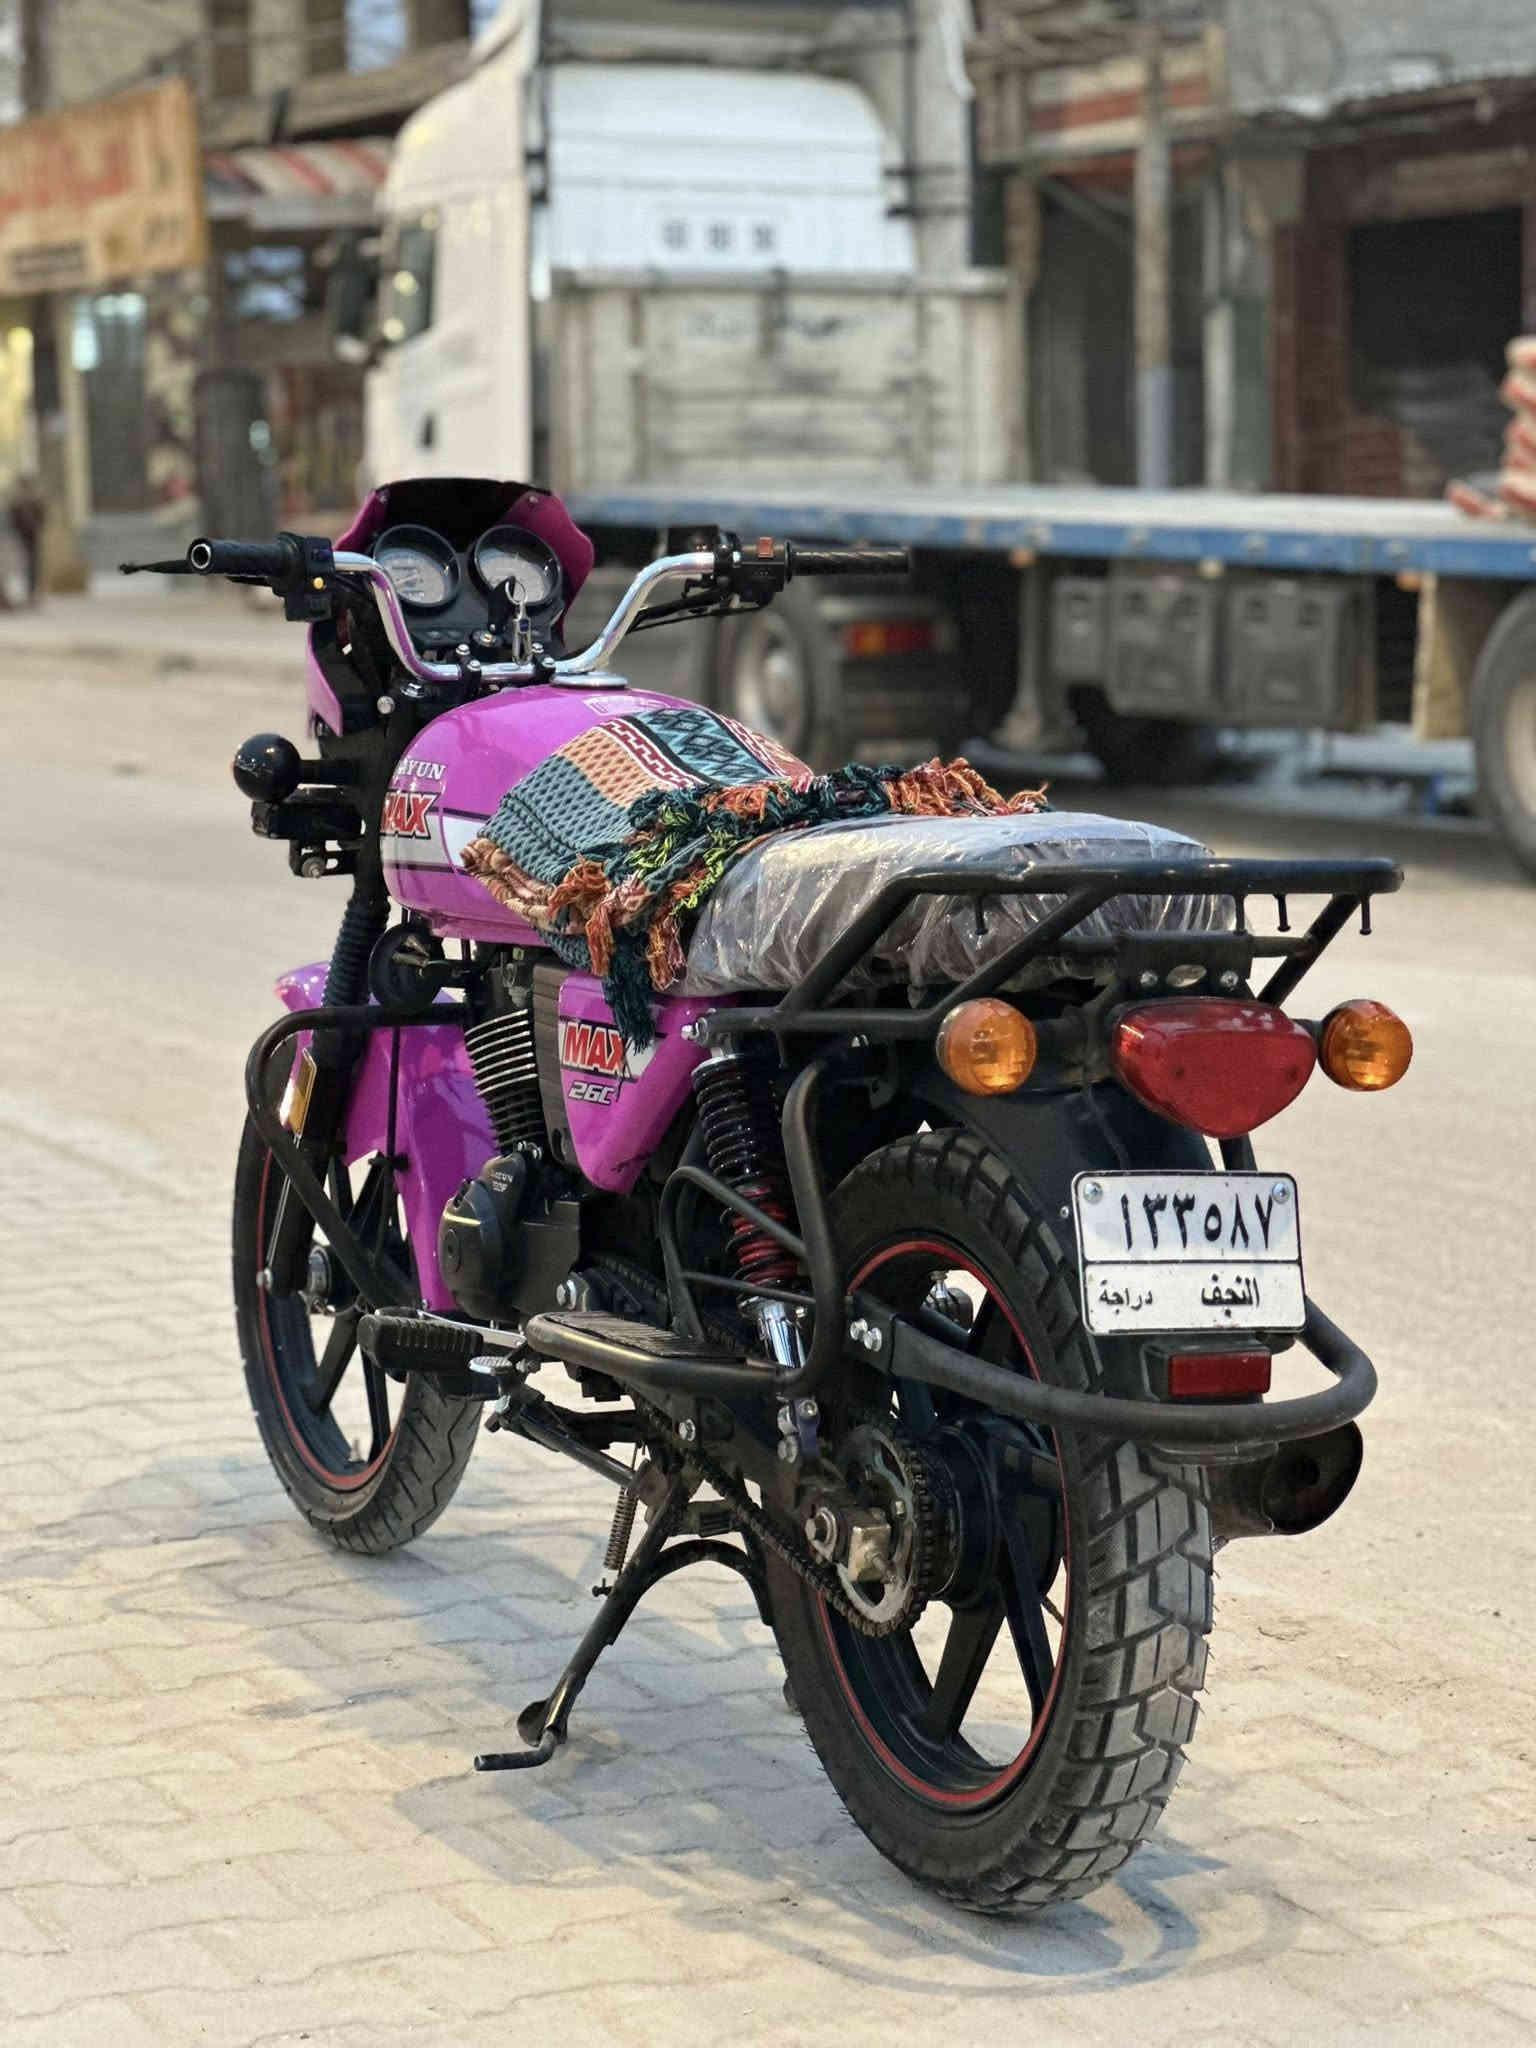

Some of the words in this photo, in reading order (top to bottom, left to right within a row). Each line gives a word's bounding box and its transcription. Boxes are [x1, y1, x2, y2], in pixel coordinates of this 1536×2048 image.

[563, 1021, 631, 1080] MAX
[1120, 1193, 1274, 1251] ١٣٣٥٨٧
[1099, 1279, 1153, 1315] دراجة
[1201, 1273, 1261, 1318] النجف
